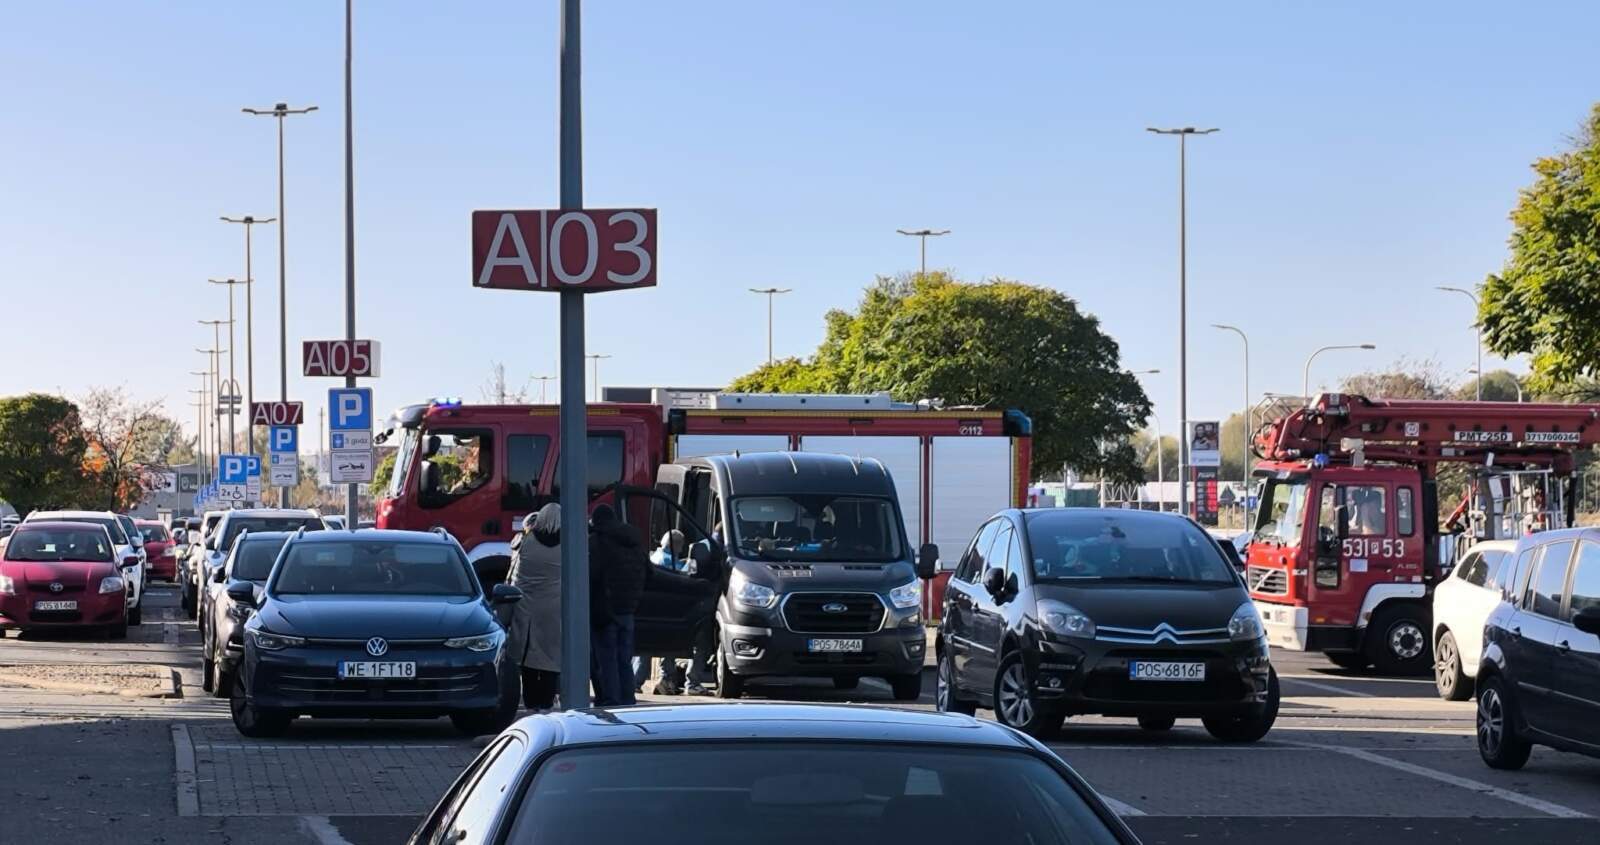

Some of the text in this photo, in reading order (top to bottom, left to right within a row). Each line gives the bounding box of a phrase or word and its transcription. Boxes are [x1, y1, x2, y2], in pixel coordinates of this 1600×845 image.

[338, 393, 363, 426] P
[276, 428, 293, 451] P
[225, 458, 243, 481] P
[1342, 538, 1369, 558] 531
[1383, 539, 1404, 558] 53
[347, 662, 413, 677] WE 1FT18
[1137, 663, 1204, 677] POS 6816F
